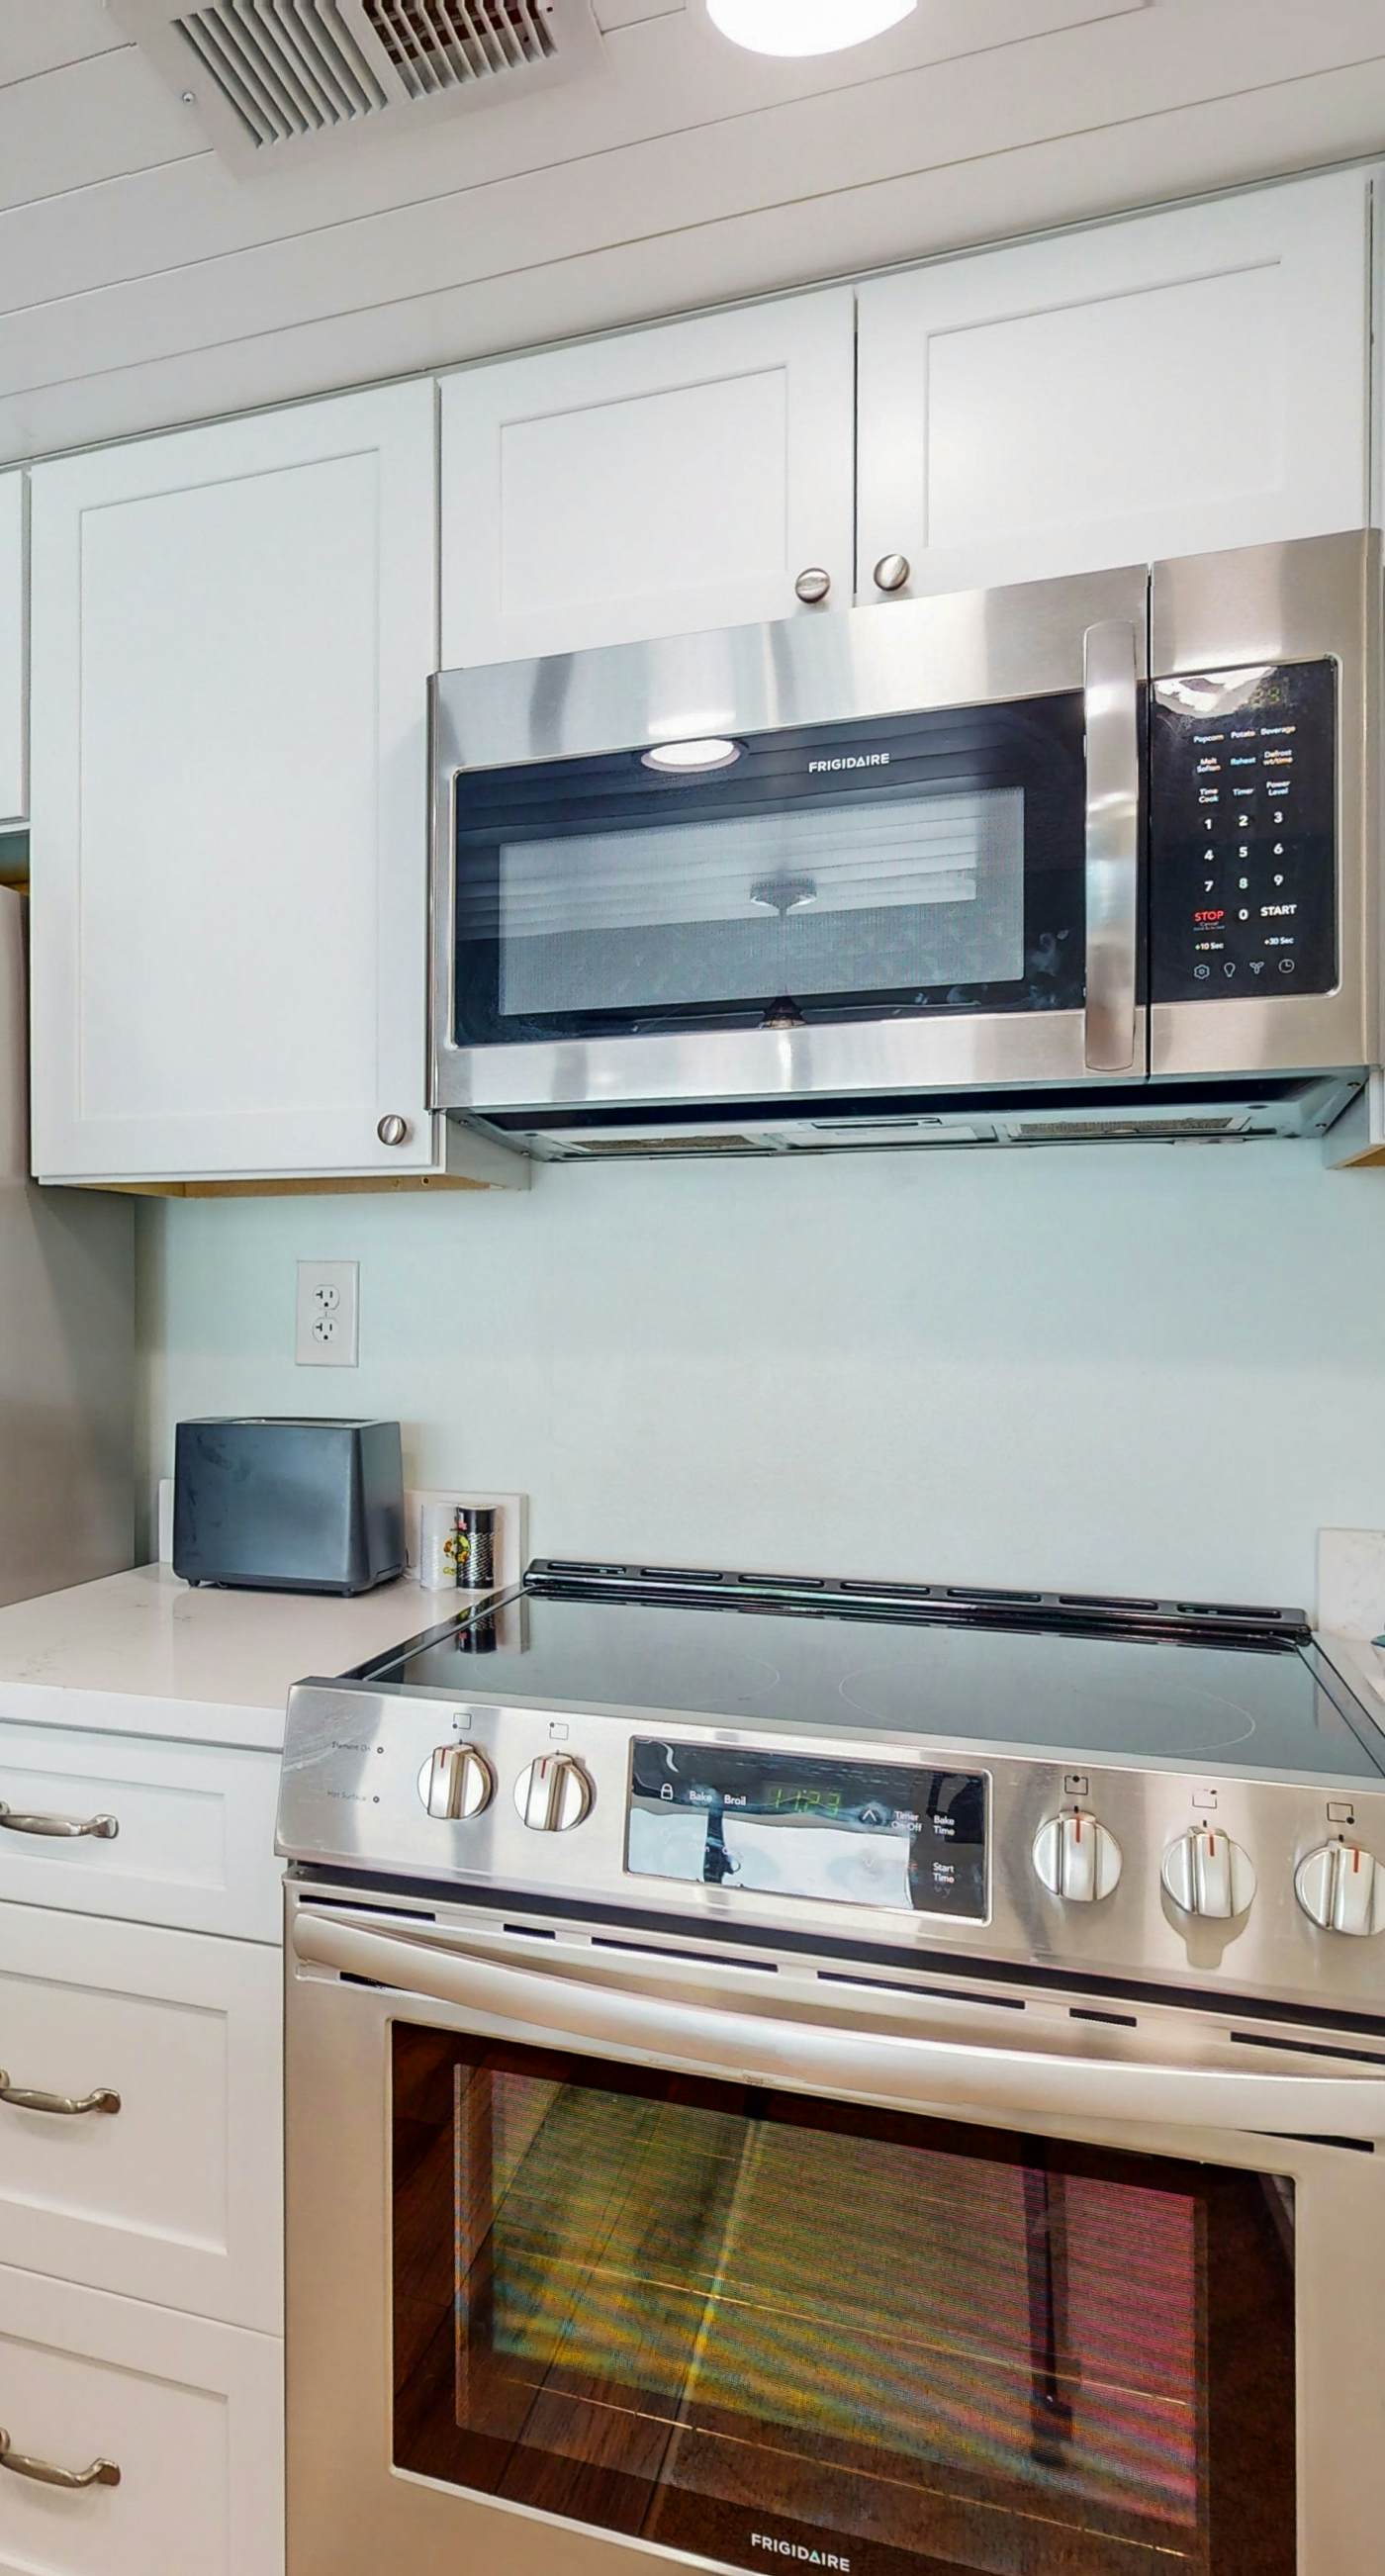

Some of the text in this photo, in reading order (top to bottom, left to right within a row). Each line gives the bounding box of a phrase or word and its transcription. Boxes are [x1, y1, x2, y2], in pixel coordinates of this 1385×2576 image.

[1231, 730, 1256, 739] Potato
[1260, 725, 1296, 735] Beverage
[1193, 734, 1225, 744] Popcorn
[808, 753, 890, 773] FRIGIDAIRE
[1268, 787, 1289, 796] Level
[1239, 815, 1248, 827] 2
[1273, 811, 1283, 823] 3
[1204, 818, 1212, 830] 1
[1204, 849, 1214, 861] 4
[1239, 846, 1248, 858] 5
[1273, 843, 1284, 855] 6
[1204, 879, 1214, 892] 7
[1239, 877, 1248, 889] 8
[1273, 874, 1284, 885] 9
[1194, 910, 1225, 922] STOP
[1239, 908, 1248, 921] 0
[1259, 904, 1297, 917] START
[1194, 942, 1209, 951] +10
[1279, 936, 1294, 945] Sec
[689, 1791, 713, 1803] Bake
[724, 1794, 747, 1806] Broil
[894, 1810, 919, 1821] Timer
[933, 1814, 956, 1826] Bake
[933, 1825, 956, 1836] Time
[933, 1862, 955, 1873] Start
[933, 1873, 956, 1884] Time
[751, 2532, 851, 2572] FRIGIDAIRE
